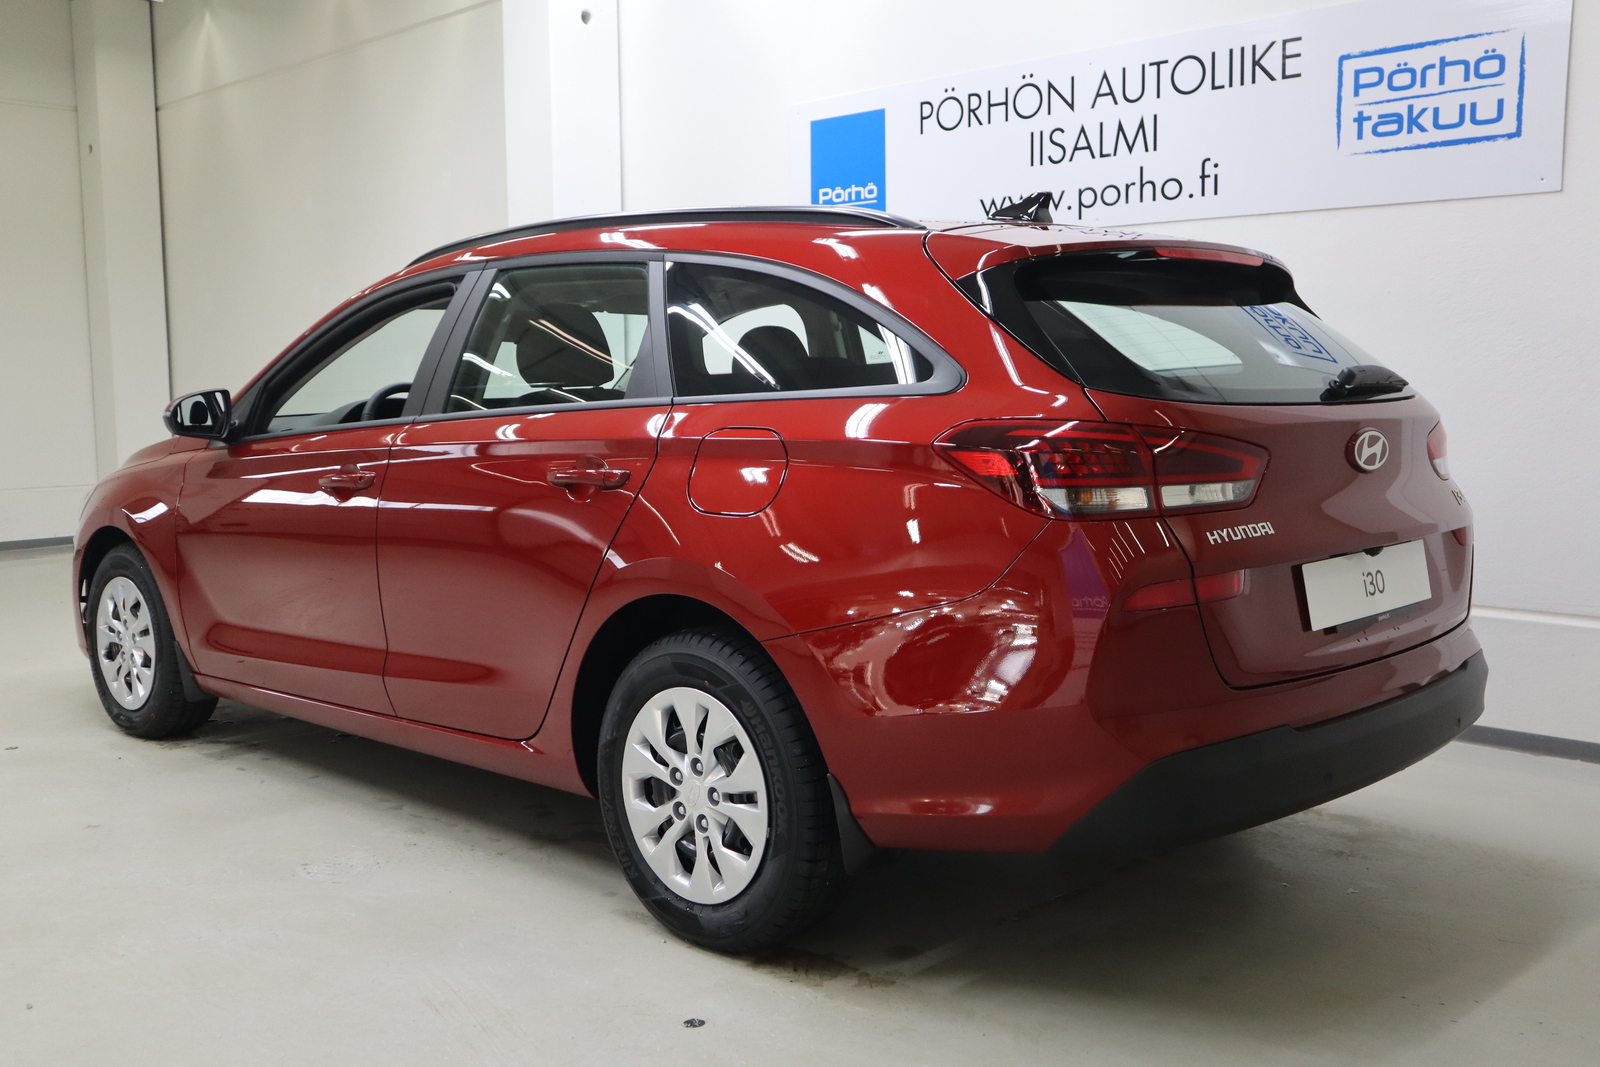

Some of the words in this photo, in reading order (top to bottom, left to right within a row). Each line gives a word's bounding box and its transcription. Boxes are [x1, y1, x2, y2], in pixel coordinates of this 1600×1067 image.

[919, 72, 1076, 135] PÖRHÖN
[1090, 35, 1303, 110] AUTOLIIKE
[1352, 47, 1507, 98] Pörhö
[1029, 113, 1159, 168] IISALMI
[1352, 97, 1505, 141] takuu
[818, 182, 879, 205] Pörhö
[979, 157, 1220, 220] w.porho.fi
[1205, 521, 1276, 546] HYUNDAI
[1361, 569, 1386, 598] i30
